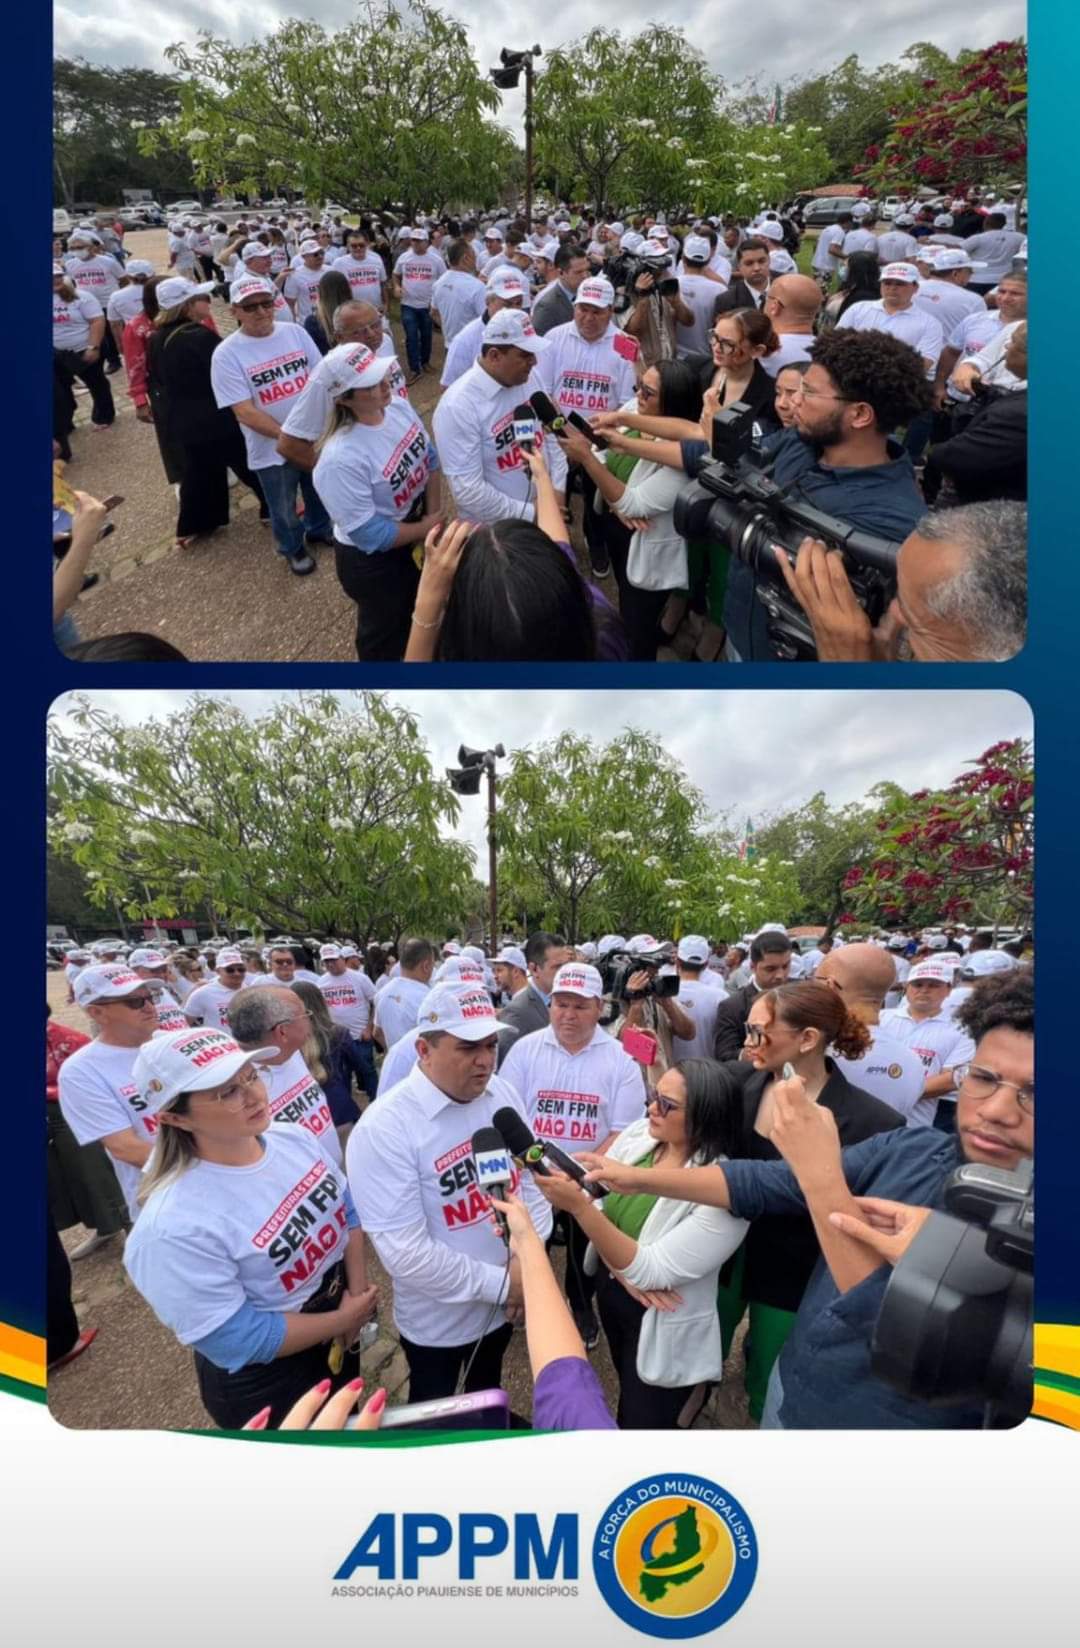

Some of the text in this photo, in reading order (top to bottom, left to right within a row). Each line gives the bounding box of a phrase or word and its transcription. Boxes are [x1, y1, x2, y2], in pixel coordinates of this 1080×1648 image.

[252, 367, 284, 387] SEM
[563, 377, 609, 393] SEM FPM
[259, 381, 294, 403] NÃO
[516, 424, 534, 436] MN
[390, 453, 414, 491] SEM
[180, 1037, 210, 1056] SEM
[191, 1046, 224, 1067] NÃO
[537, 1099, 599, 1118] SEM FPM
[533, 1114, 597, 1139] NÃO DÁ!
[479, 1156, 508, 1176] MN
[255, 1183, 310, 1246] PREFEITURAS
[442, 1183, 494, 1226] NÃ
[269, 1205, 316, 1267] SEM
[280, 1223, 338, 1292] NÃO
